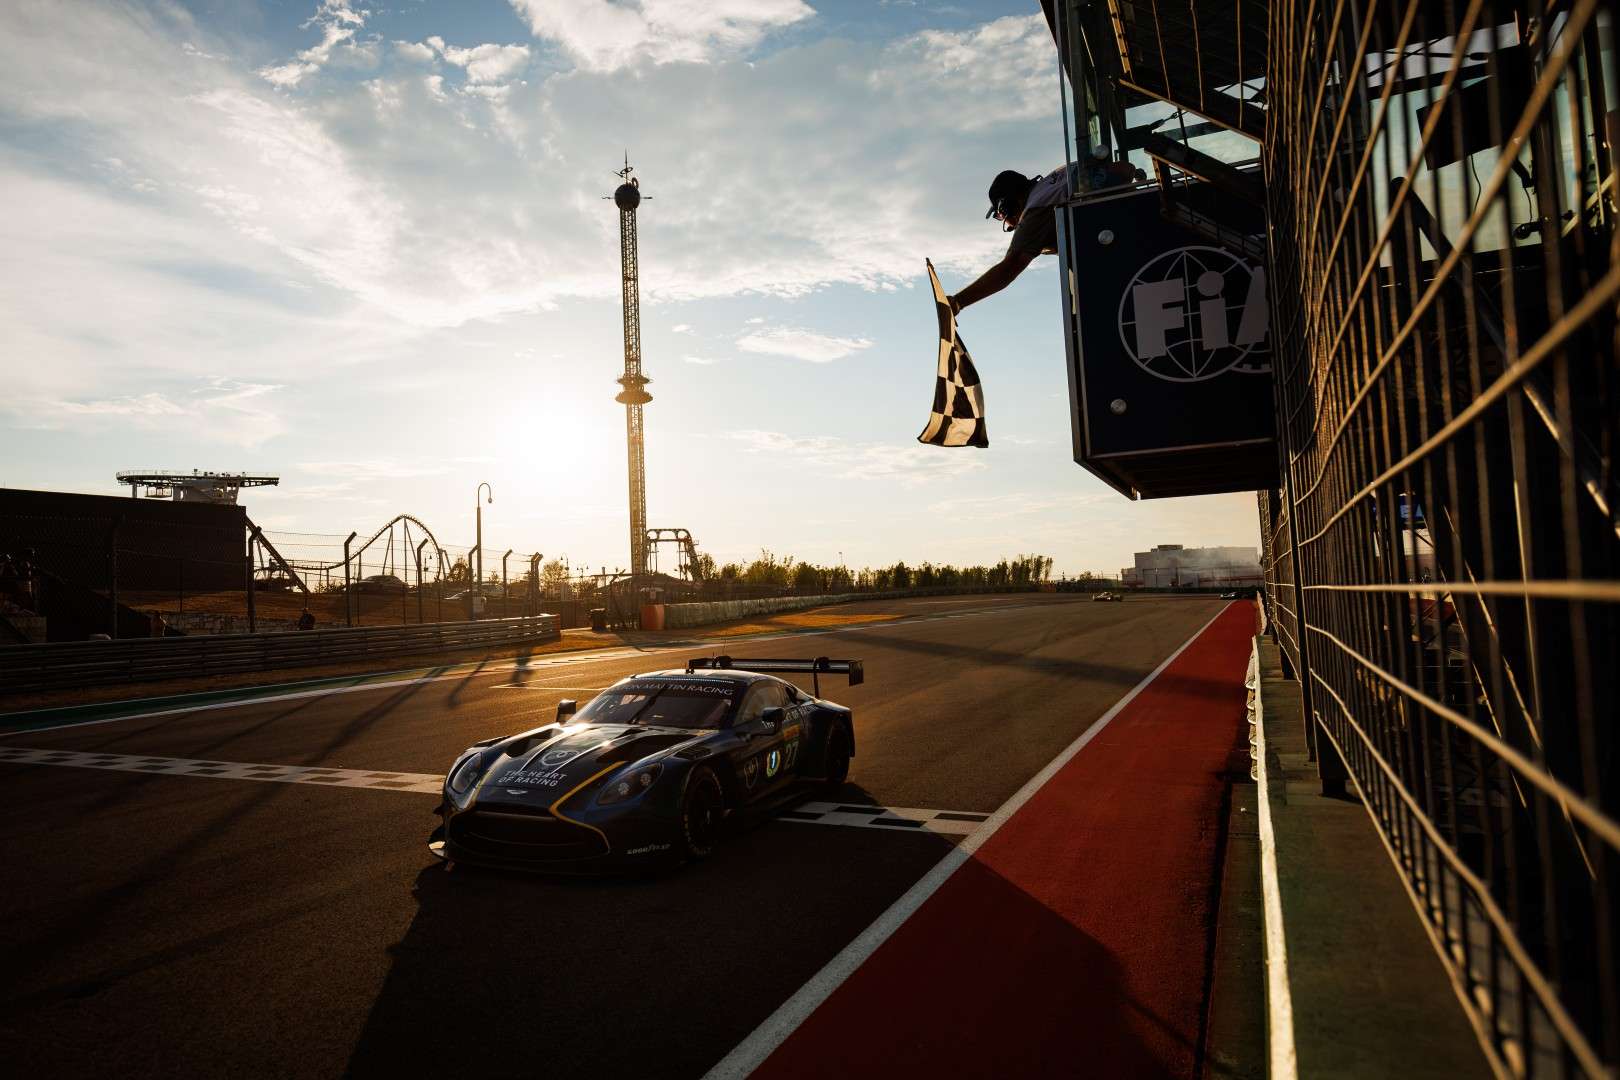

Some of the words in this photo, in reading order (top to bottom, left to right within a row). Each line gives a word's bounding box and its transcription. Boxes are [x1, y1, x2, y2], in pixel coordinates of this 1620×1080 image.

[688, 684, 734, 696] RACING
[784, 740, 799, 770] 27
[504, 769, 527, 777] THE
[528, 771, 568, 781] HEART
[497, 776, 514, 784] OF
[515, 777, 559, 787] RACING
